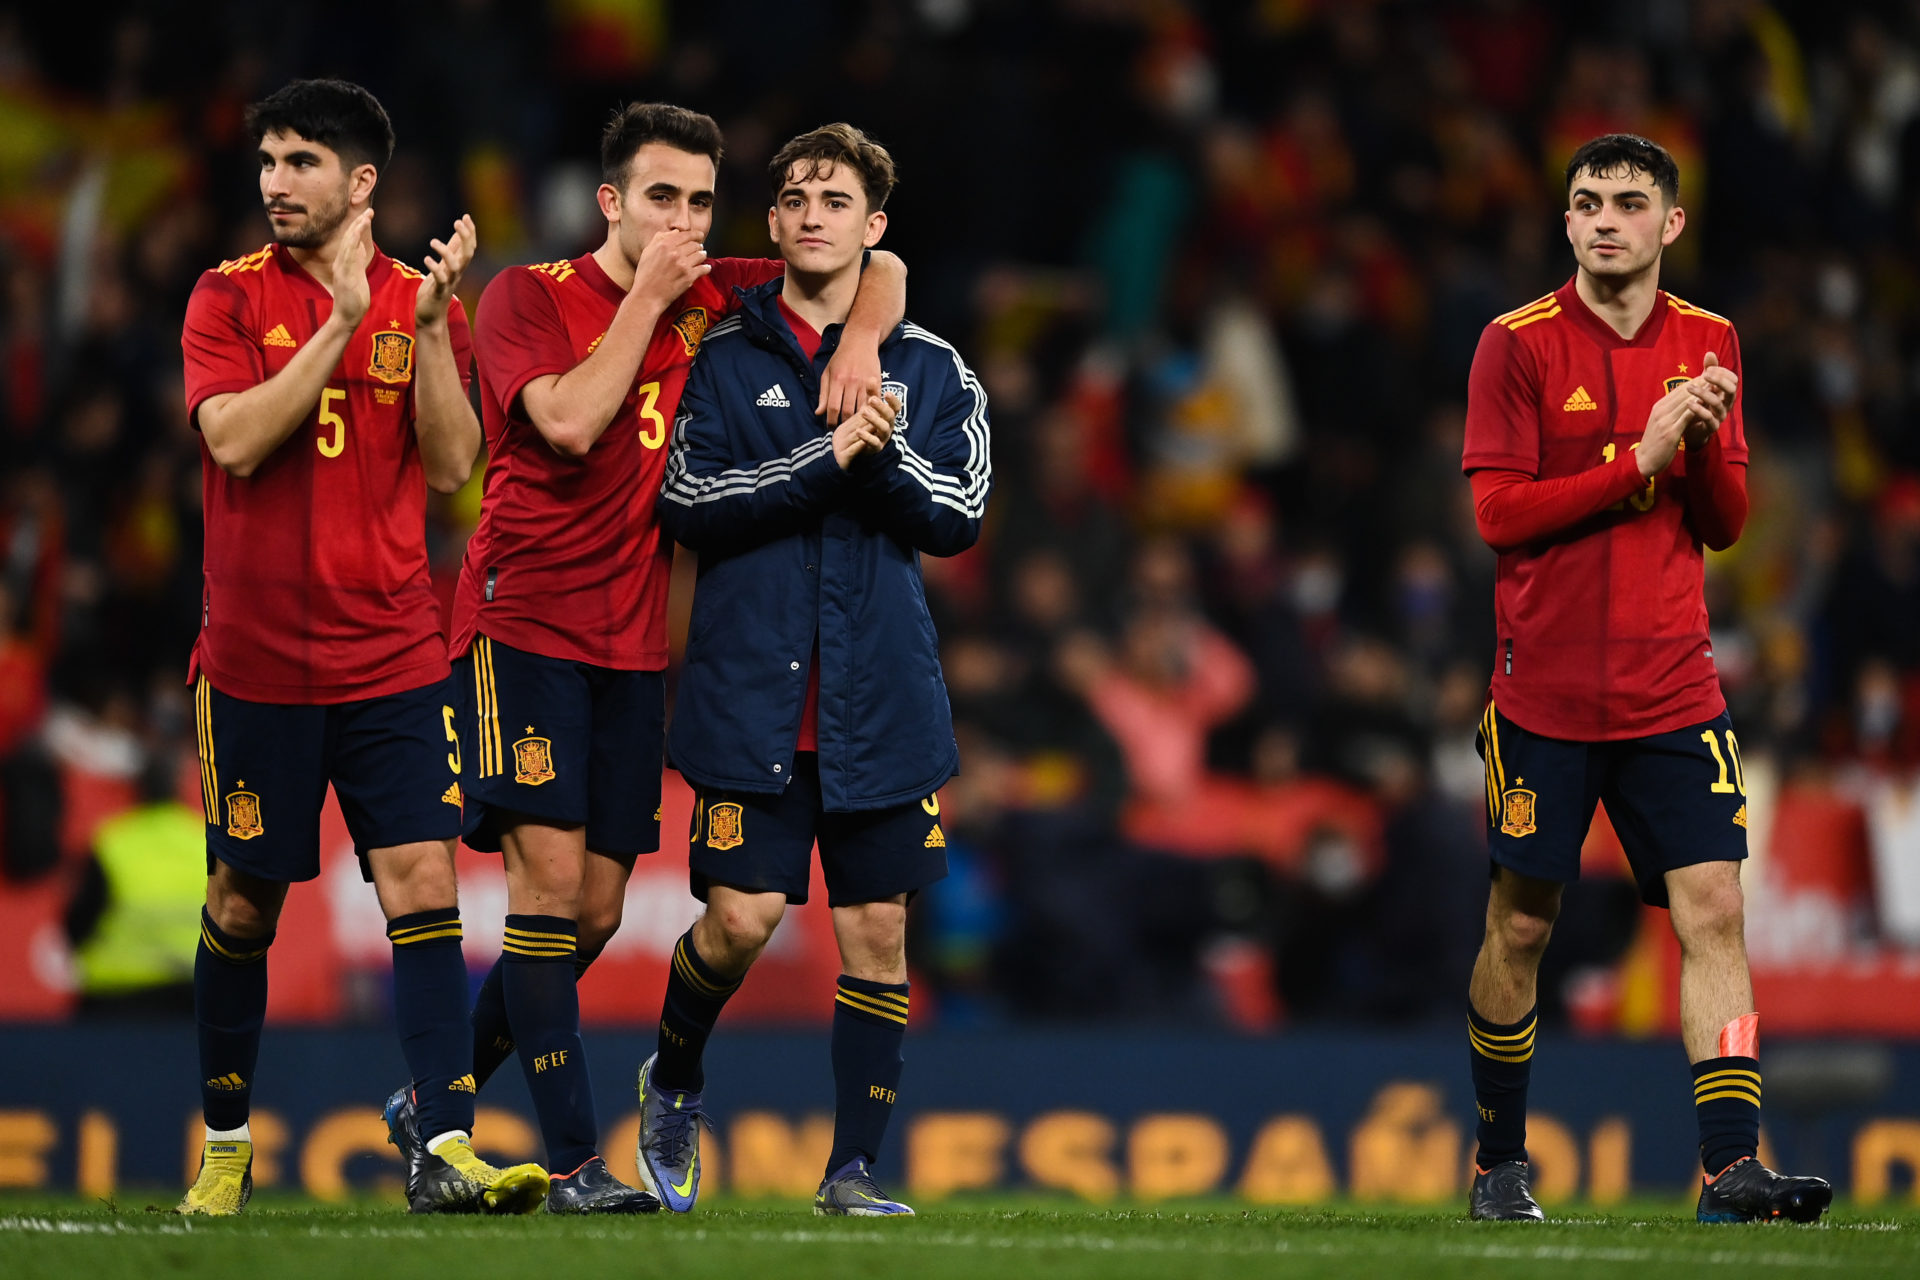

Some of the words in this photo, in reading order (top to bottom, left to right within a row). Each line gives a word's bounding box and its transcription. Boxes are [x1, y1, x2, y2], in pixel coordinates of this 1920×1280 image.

[263, 337, 297, 348] adidas
[317, 387, 346, 458] 5
[638, 381, 666, 450] 3
[756, 397, 791, 408] adidas
[1563, 401, 1598, 412] adidas
[442, 704, 462, 775] 5
[1700, 729, 1747, 798] 10
[533, 1049, 569, 1074] RFEF
